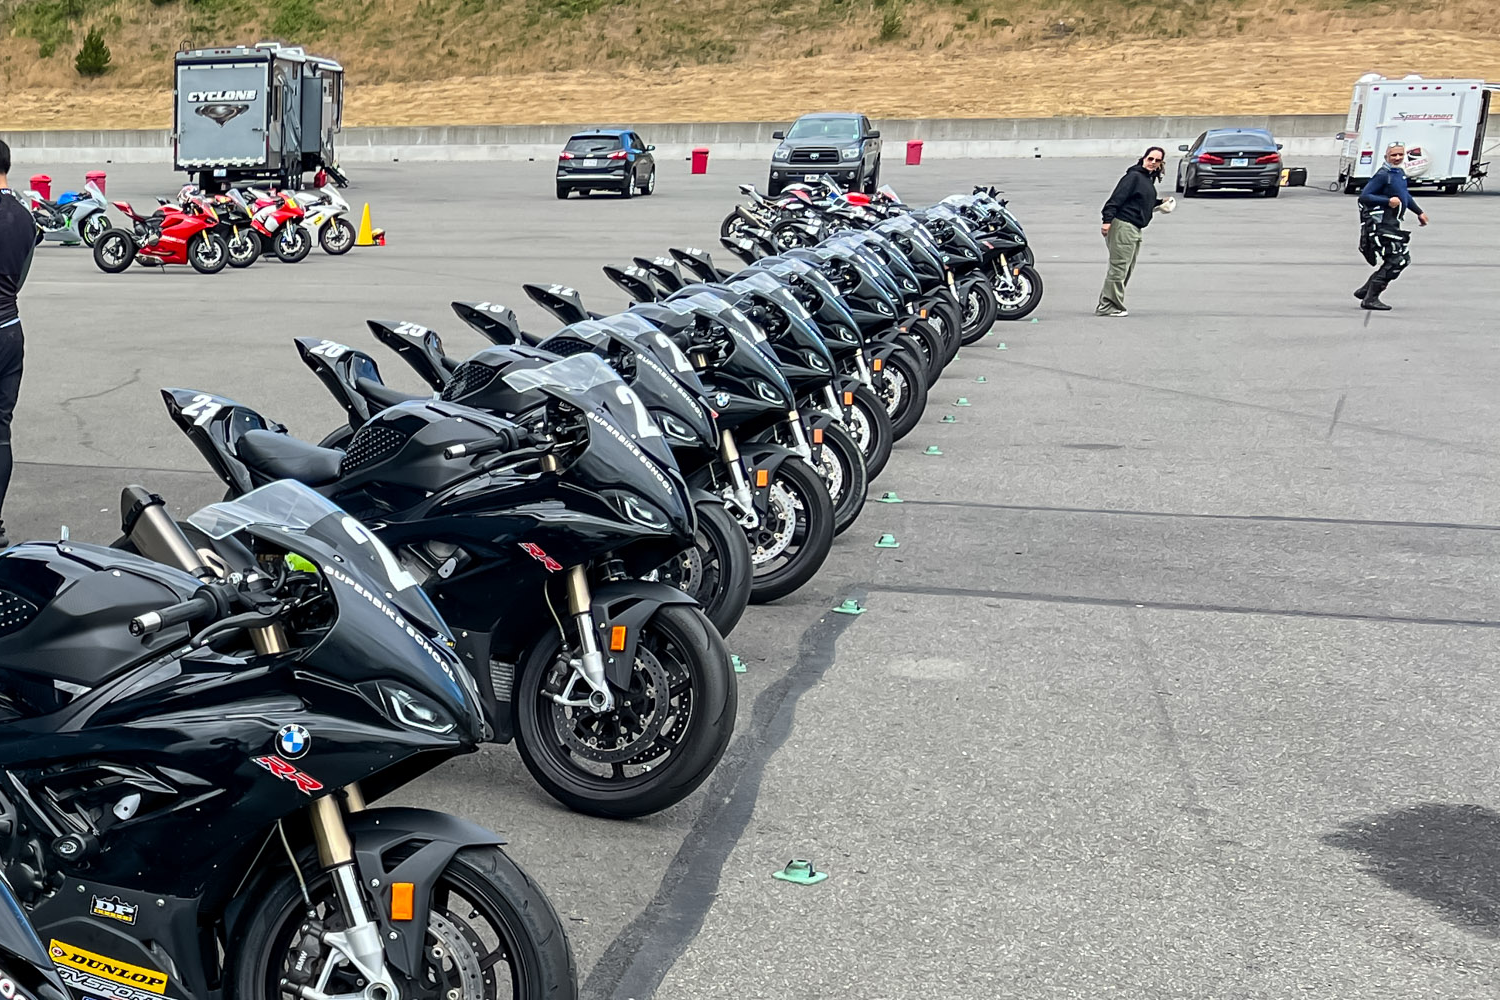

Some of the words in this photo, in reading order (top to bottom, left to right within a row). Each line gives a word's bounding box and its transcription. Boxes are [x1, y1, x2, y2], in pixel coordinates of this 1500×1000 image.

[188, 90, 257, 102] CYCLONE
[548, 283, 575, 297] 22
[309, 339, 350, 358] 26
[181, 394, 222, 426] 27
[341, 516, 418, 592] 2
[323, 565, 405, 628] SUPERBIKE
[405, 625, 456, 683] SCHOOL
[255, 755, 324, 796] RR
[95, 899, 135, 916] DP
[69, 953, 165, 987] DUNLOP
